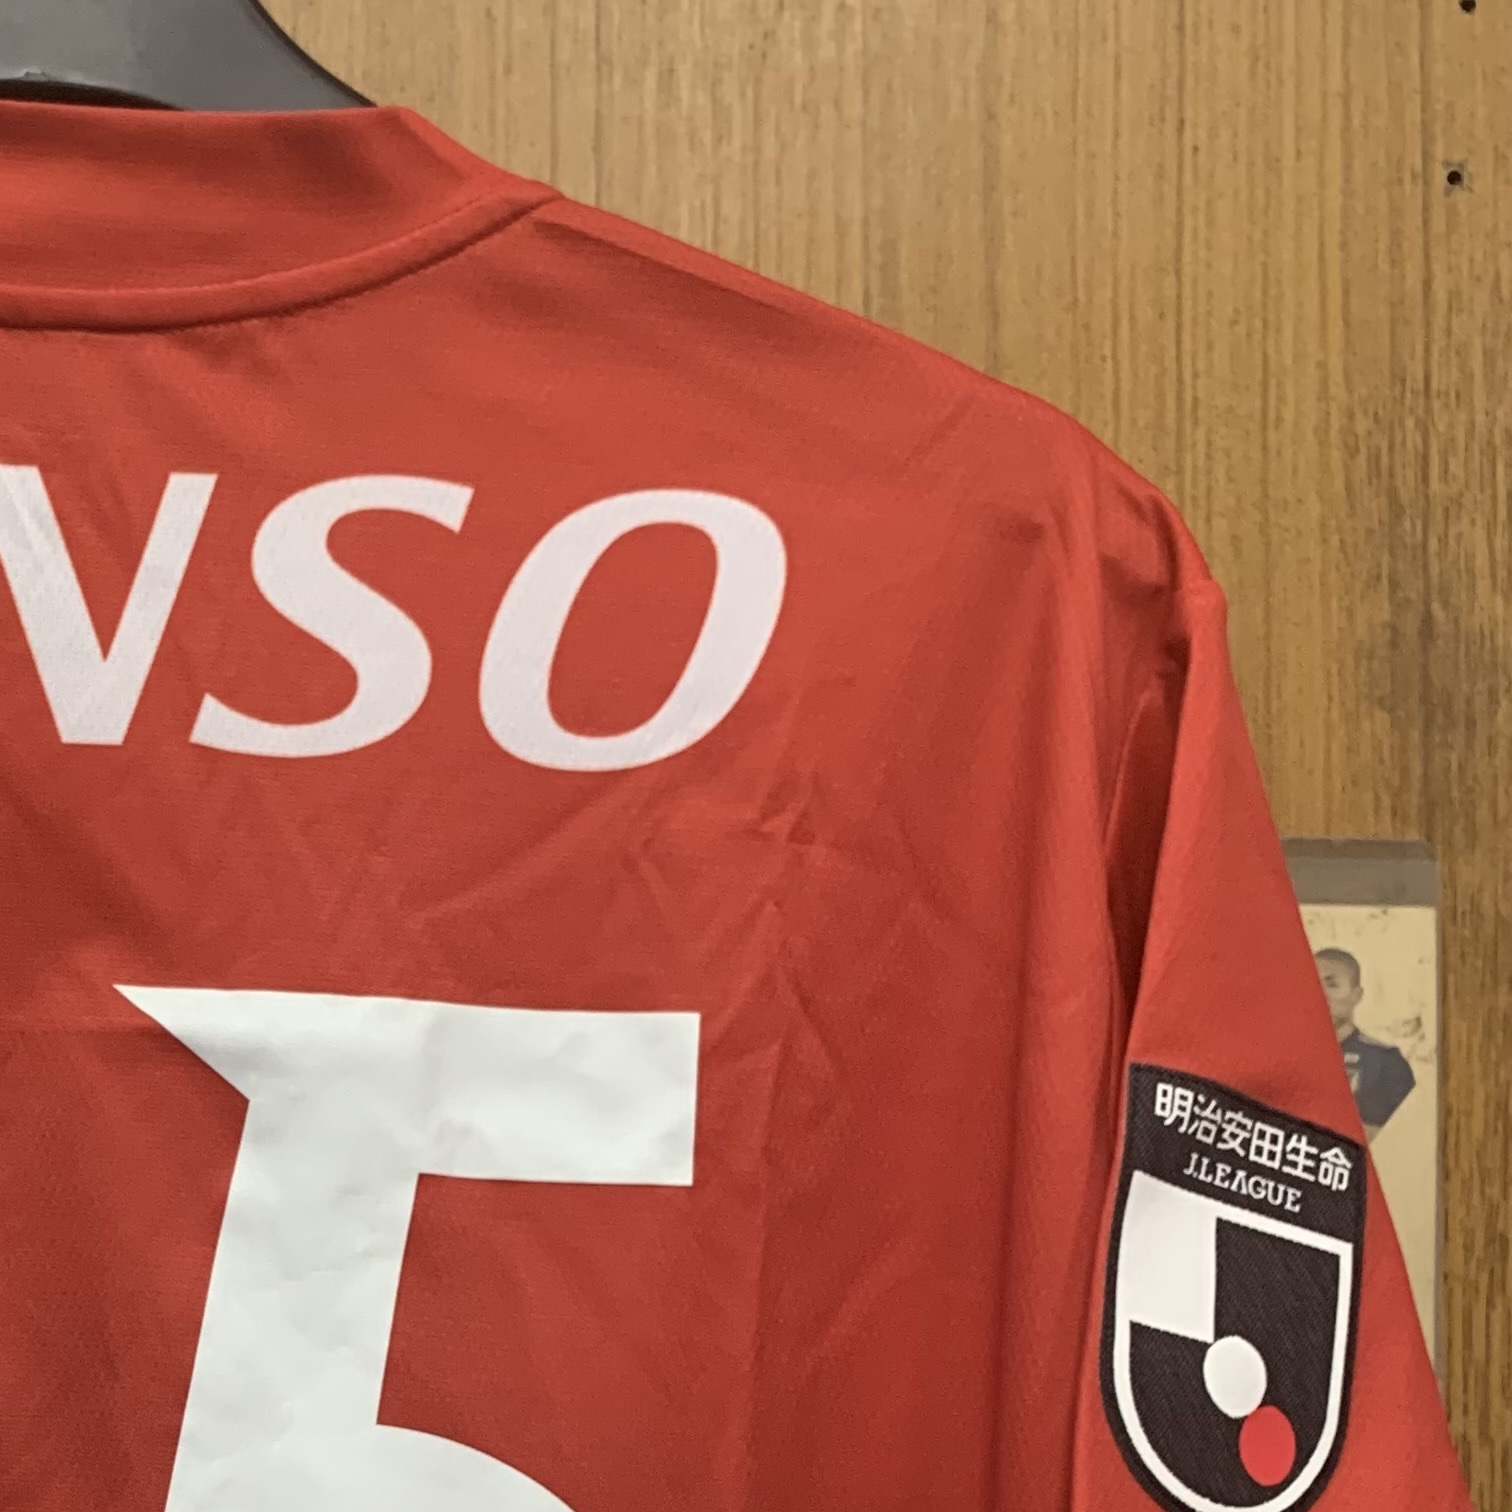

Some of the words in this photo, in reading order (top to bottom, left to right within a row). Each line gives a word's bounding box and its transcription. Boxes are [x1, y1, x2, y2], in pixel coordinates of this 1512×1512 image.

[1153, 1081, 1353, 1192] 明治安田生命
[1183, 1152, 1302, 1213] J.LEAGUE
